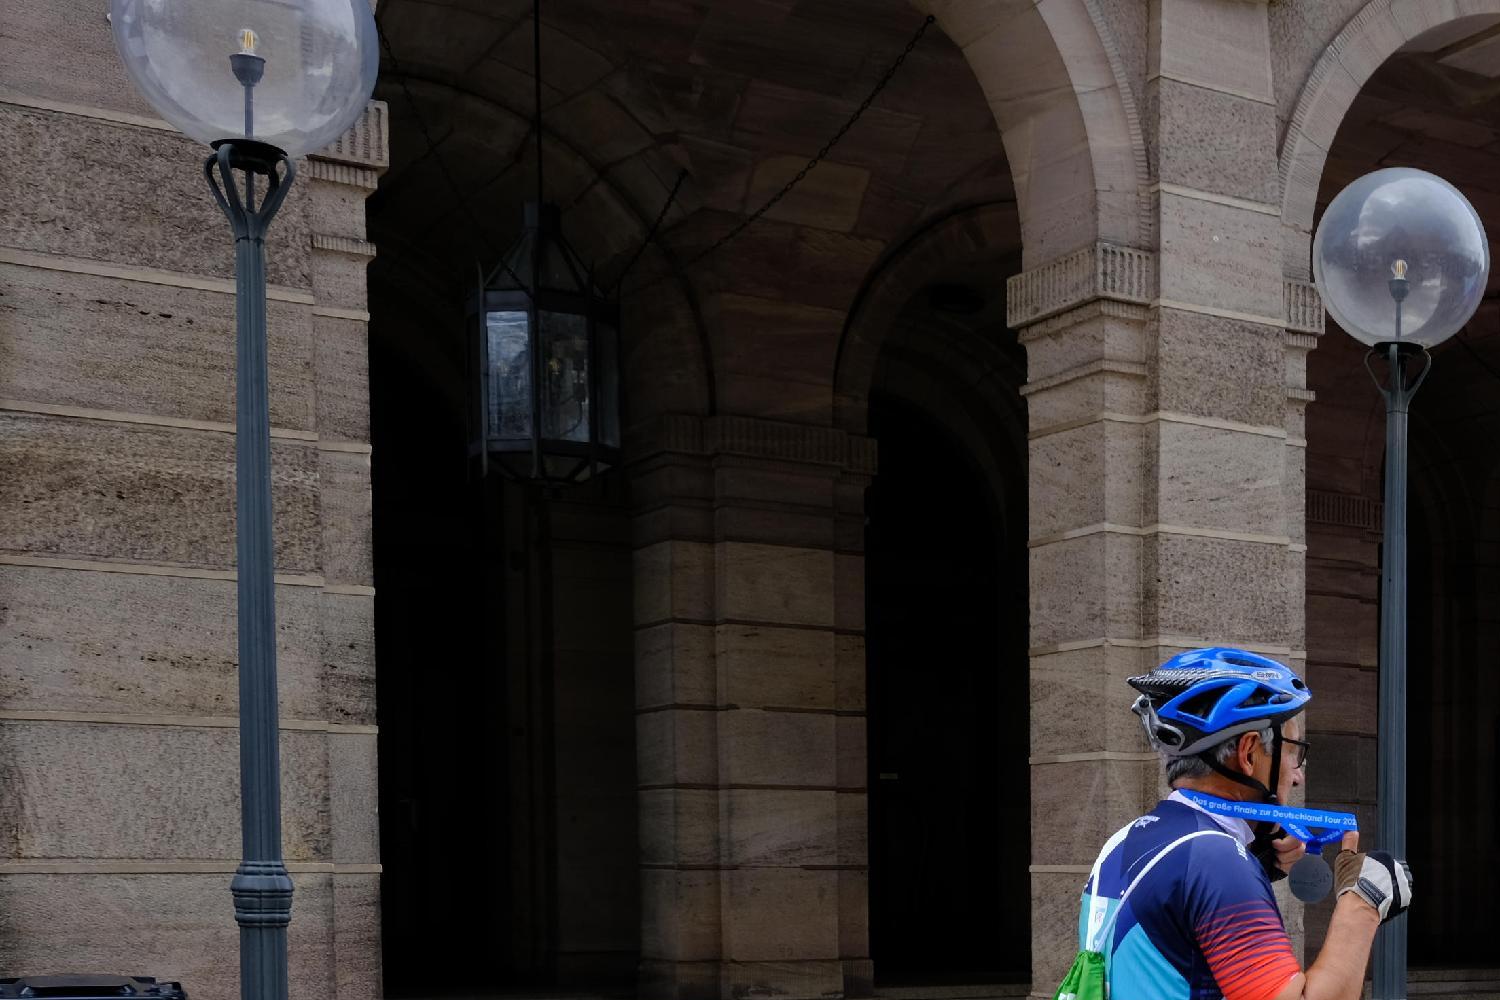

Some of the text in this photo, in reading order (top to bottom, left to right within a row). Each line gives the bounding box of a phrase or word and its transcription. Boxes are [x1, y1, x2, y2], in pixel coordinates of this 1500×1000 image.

[1192, 795, 1208, 807] Das
[1208, 801, 1233, 812] große
[1233, 804, 1258, 815] Finale
[1259, 808, 1271, 817] zur
[1273, 809, 1323, 823] Deutschland
[1324, 815, 1341, 825] Tour
